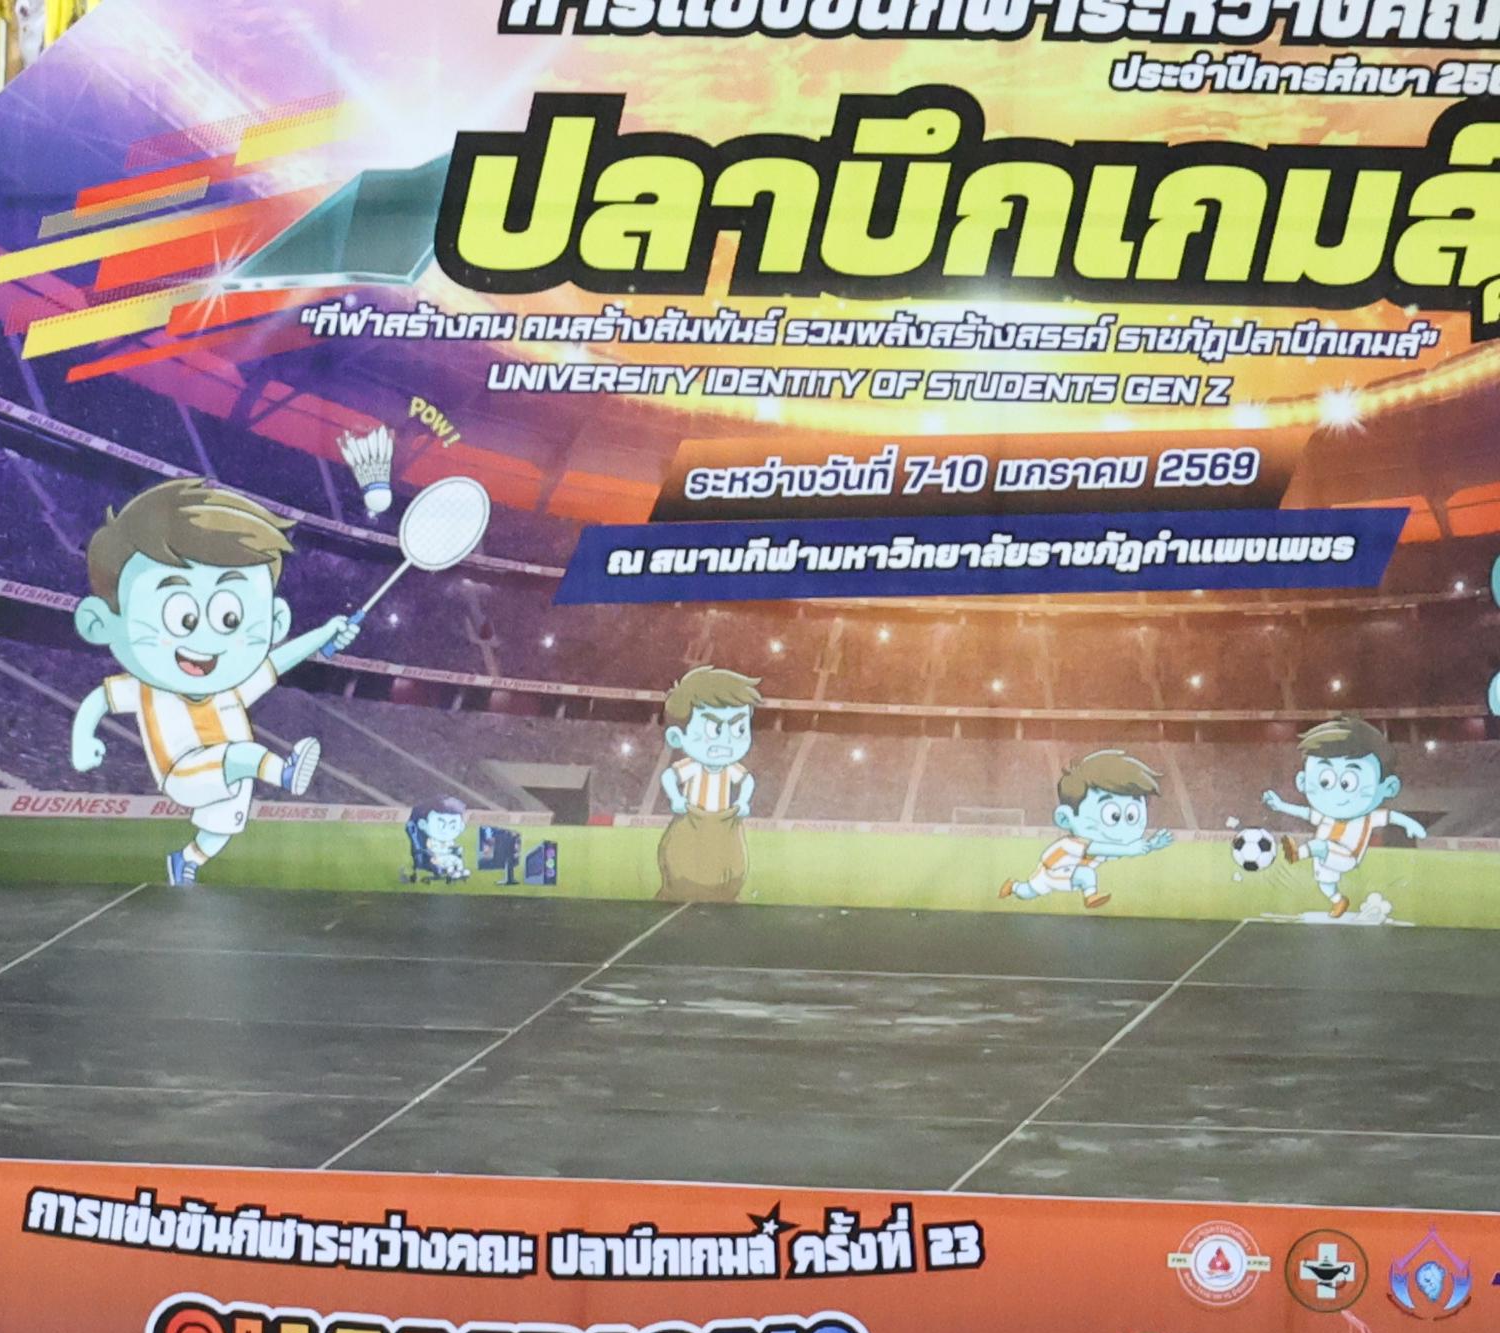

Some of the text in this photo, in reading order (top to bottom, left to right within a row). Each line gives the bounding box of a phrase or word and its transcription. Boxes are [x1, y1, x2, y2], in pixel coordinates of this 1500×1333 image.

[1112, 52, 1431, 94] ประจำปีการศึกษา
[487, 363, 1233, 405] UNIVERSITY IDENTITY OF STUDENTS GEN Z
[687, 446, 1259, 497] ระหว่างวันที่ 7-10 มกราคม 2569
[607, 549, 644, 575] ณ
[10, 794, 130, 816] BUSINESS
[27, 1190, 534, 1274] การแข่งขันกีฬาระหว่างคณะ
[793, 1206, 912, 1274] ครั้งที่
[928, 1223, 981, 1267] 23
